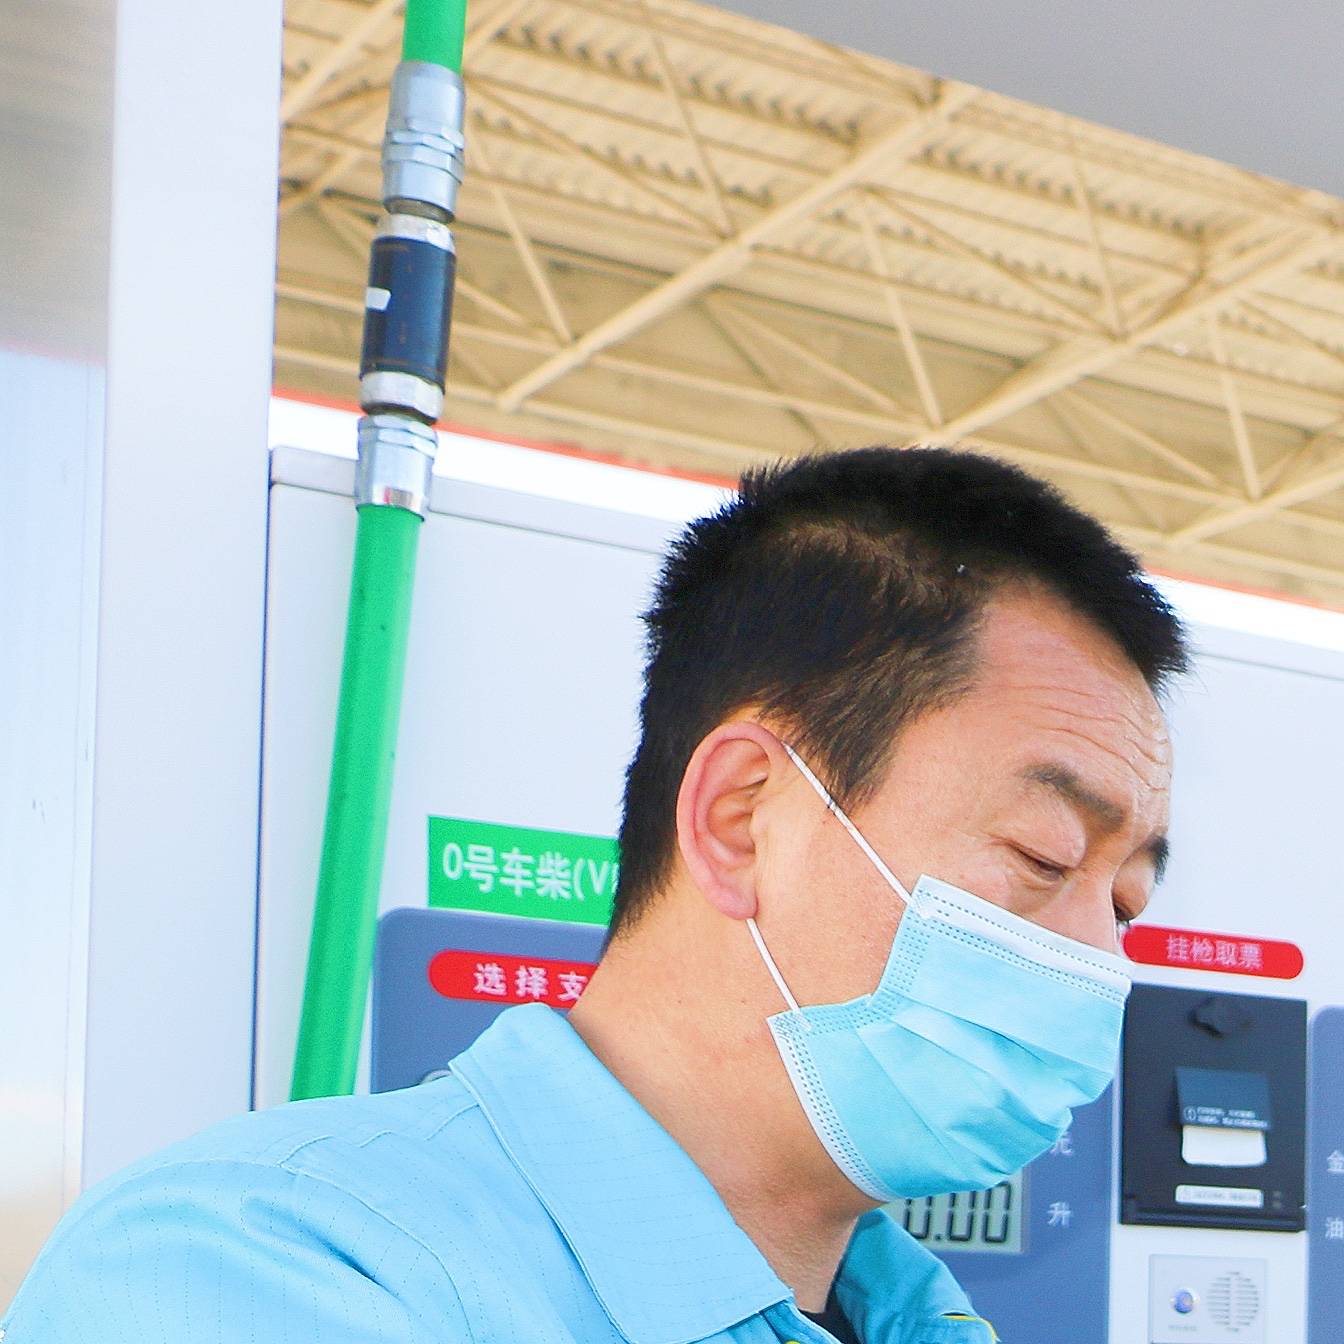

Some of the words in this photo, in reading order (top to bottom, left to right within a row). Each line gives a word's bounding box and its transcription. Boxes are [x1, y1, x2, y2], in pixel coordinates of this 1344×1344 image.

[1166, 934, 1263, 970] 挂枪取票
[1047, 1201, 1072, 1227] 升
